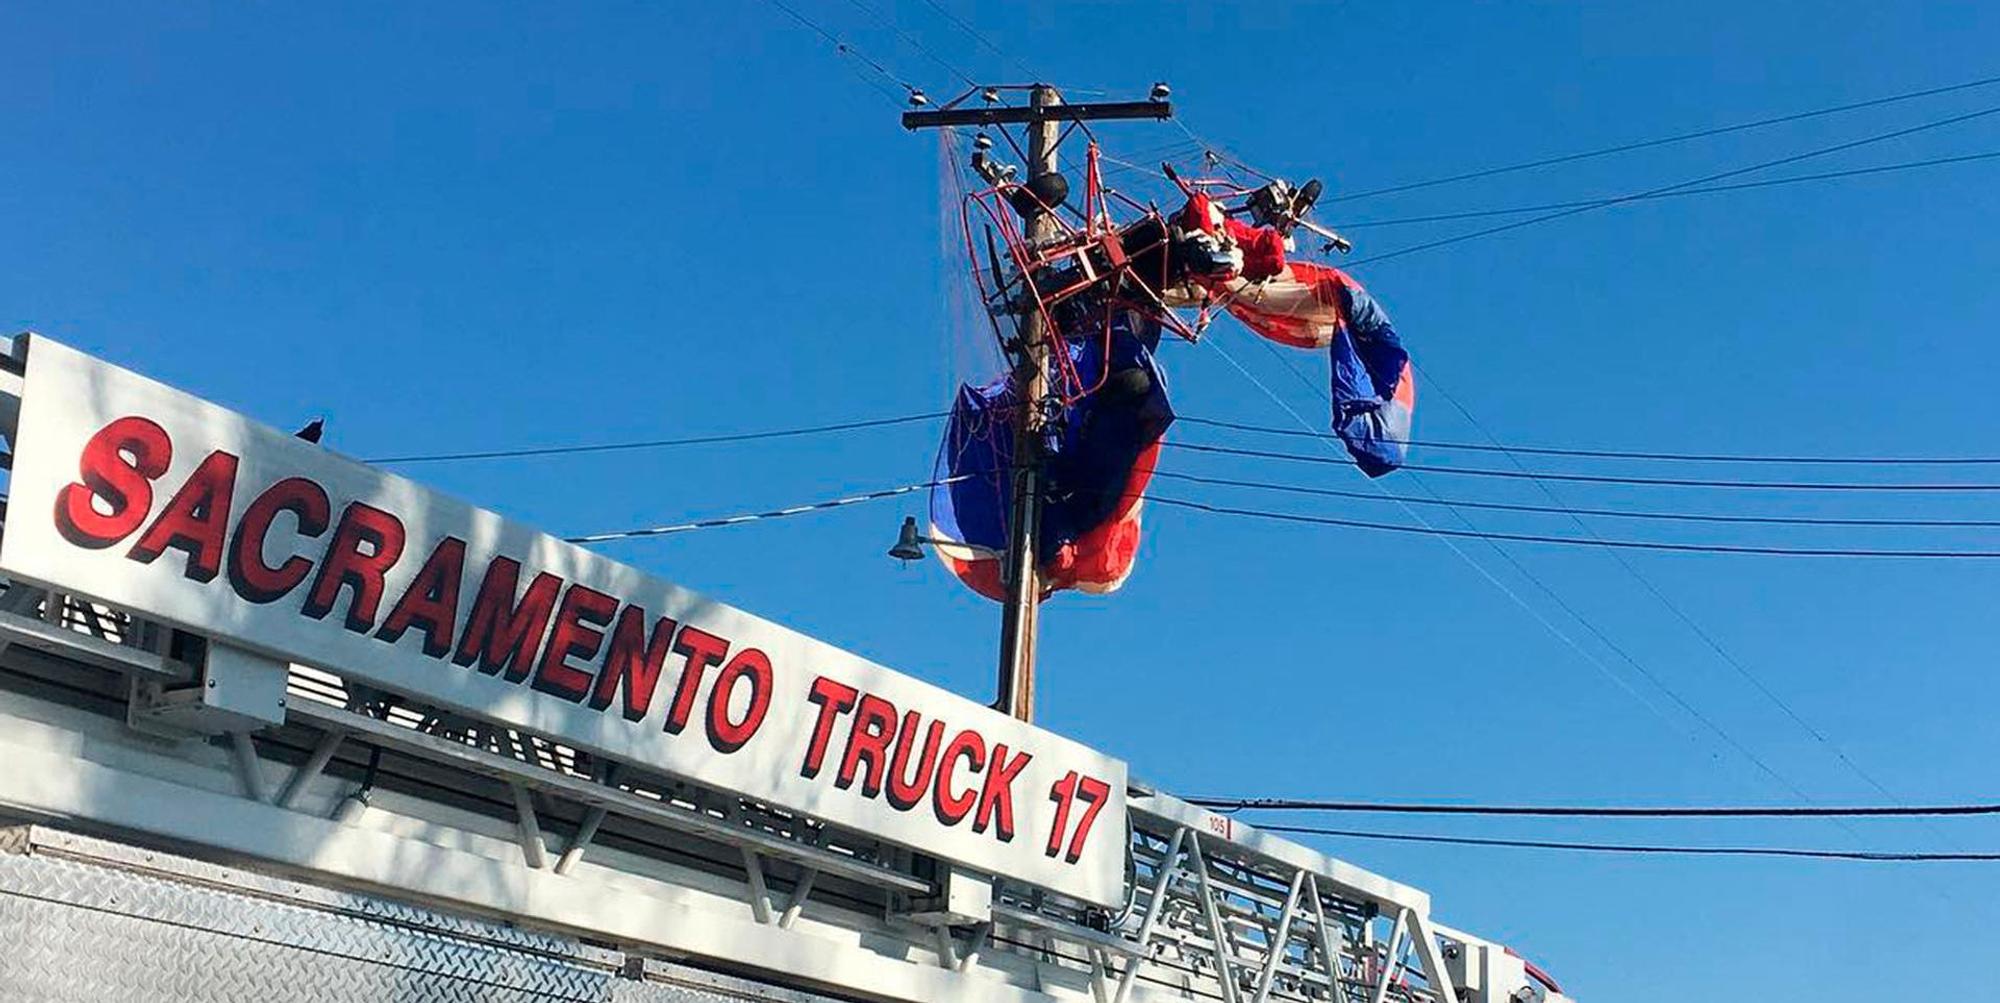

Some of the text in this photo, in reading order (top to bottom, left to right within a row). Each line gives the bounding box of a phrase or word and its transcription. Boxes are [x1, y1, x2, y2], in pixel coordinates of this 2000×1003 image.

[54, 415, 1111, 865] SACRAMENTO TRUCK 17
[1208, 816, 1225, 834] 105
